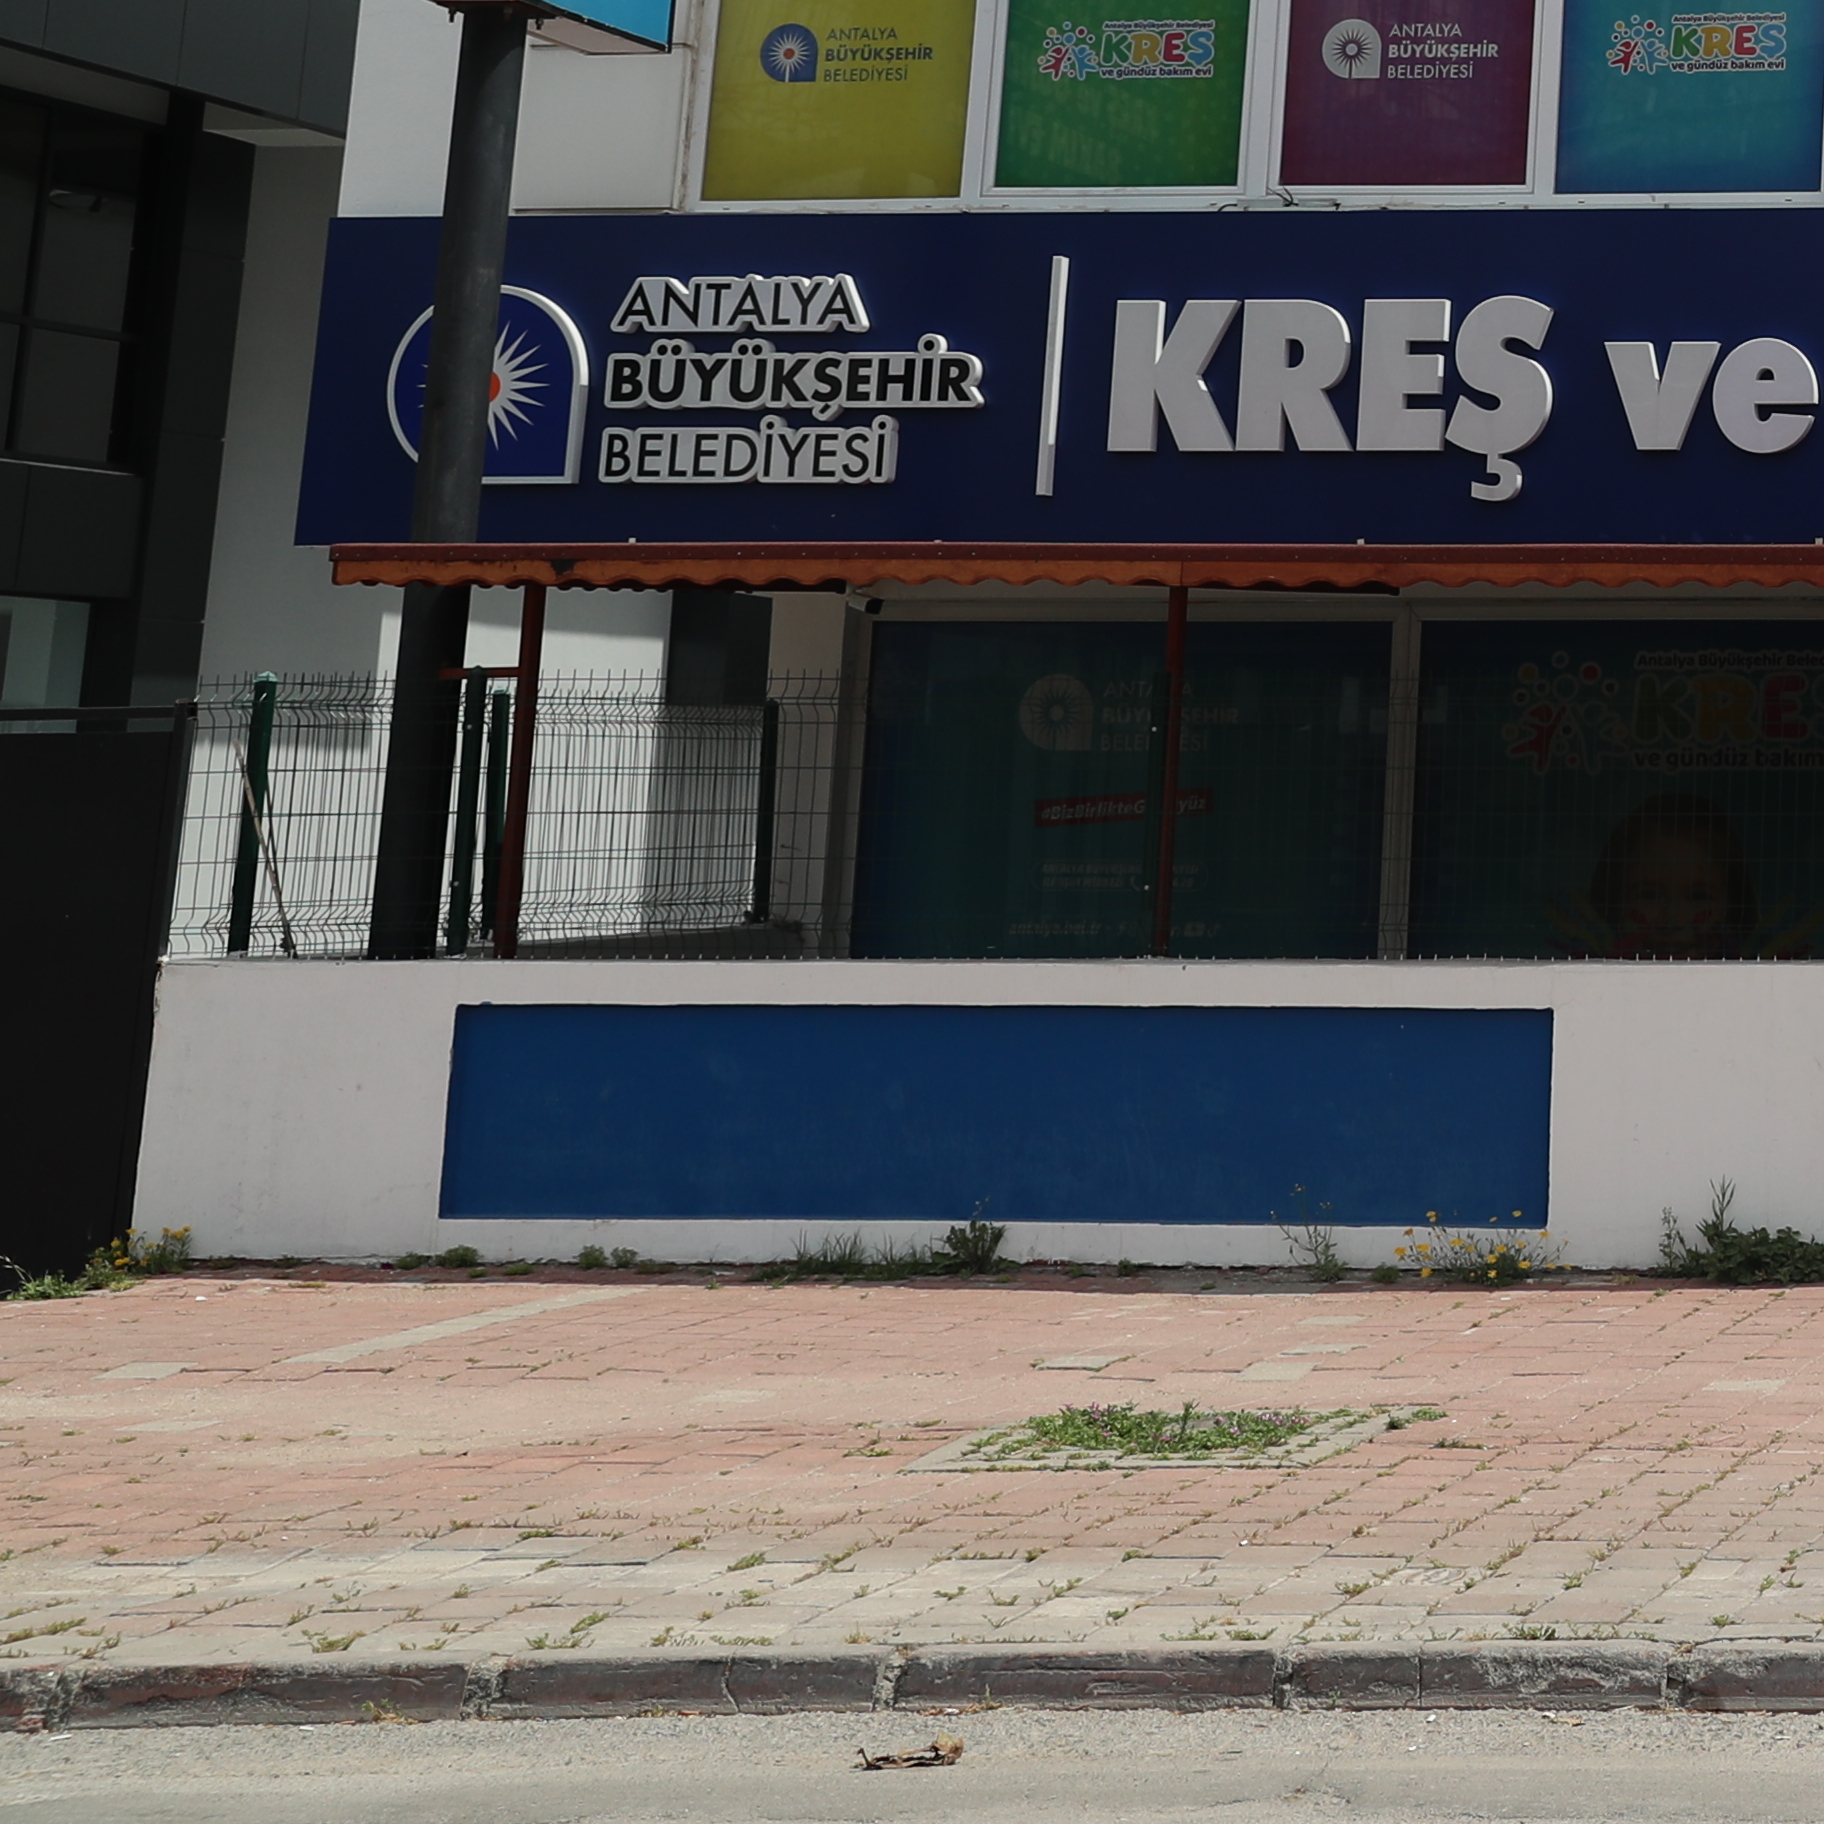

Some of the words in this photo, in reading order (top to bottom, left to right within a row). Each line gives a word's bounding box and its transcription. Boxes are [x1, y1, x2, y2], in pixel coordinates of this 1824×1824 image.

[826, 28, 898, 41] ANTALYA
[1389, 24, 1462, 37] ANTALYA
[1671, 23, 1786, 59] KREŞ
[825, 43, 933, 64] BÜYÜKŞEHİR
[1101, 30, 1214, 66] KREŞ
[1388, 40, 1498, 61] BÜYÜKŞEHİR
[824, 65, 908, 82] BELEDİYESİ
[1101, 68, 1114, 76] ve
[1116, 67, 1156, 78] gündüz
[1159, 67, 1192, 76] bakım
[1195, 66, 1211, 76] evi
[1388, 61, 1473, 78] BELEDİYESİ
[1672, 62, 1684, 70] ve
[1687, 60, 1728, 72] gündüz
[1731, 60, 1765, 69] bakım
[1768, 59, 1784, 69] evi
[614, 277, 862, 329] ANTALYA
[609, 337, 976, 415] BÜYÜKŞEHİR
[1106, 296, 1553, 501] KREŞ
[1604, 337, 1819, 452] ve
[603, 417, 891, 480] BELEDİYESİ
[1638, 654, 1694, 667] Antalya
[1699, 652, 1782, 668] Büyükşehir
[1103, 681, 1193, 698] ANTA
[1101, 730, 1208, 751] BELEESİ
[1635, 751, 1660, 767] ve
[1666, 747, 1749, 770] gündüz
[1756, 749, 1824, 766] bakım
